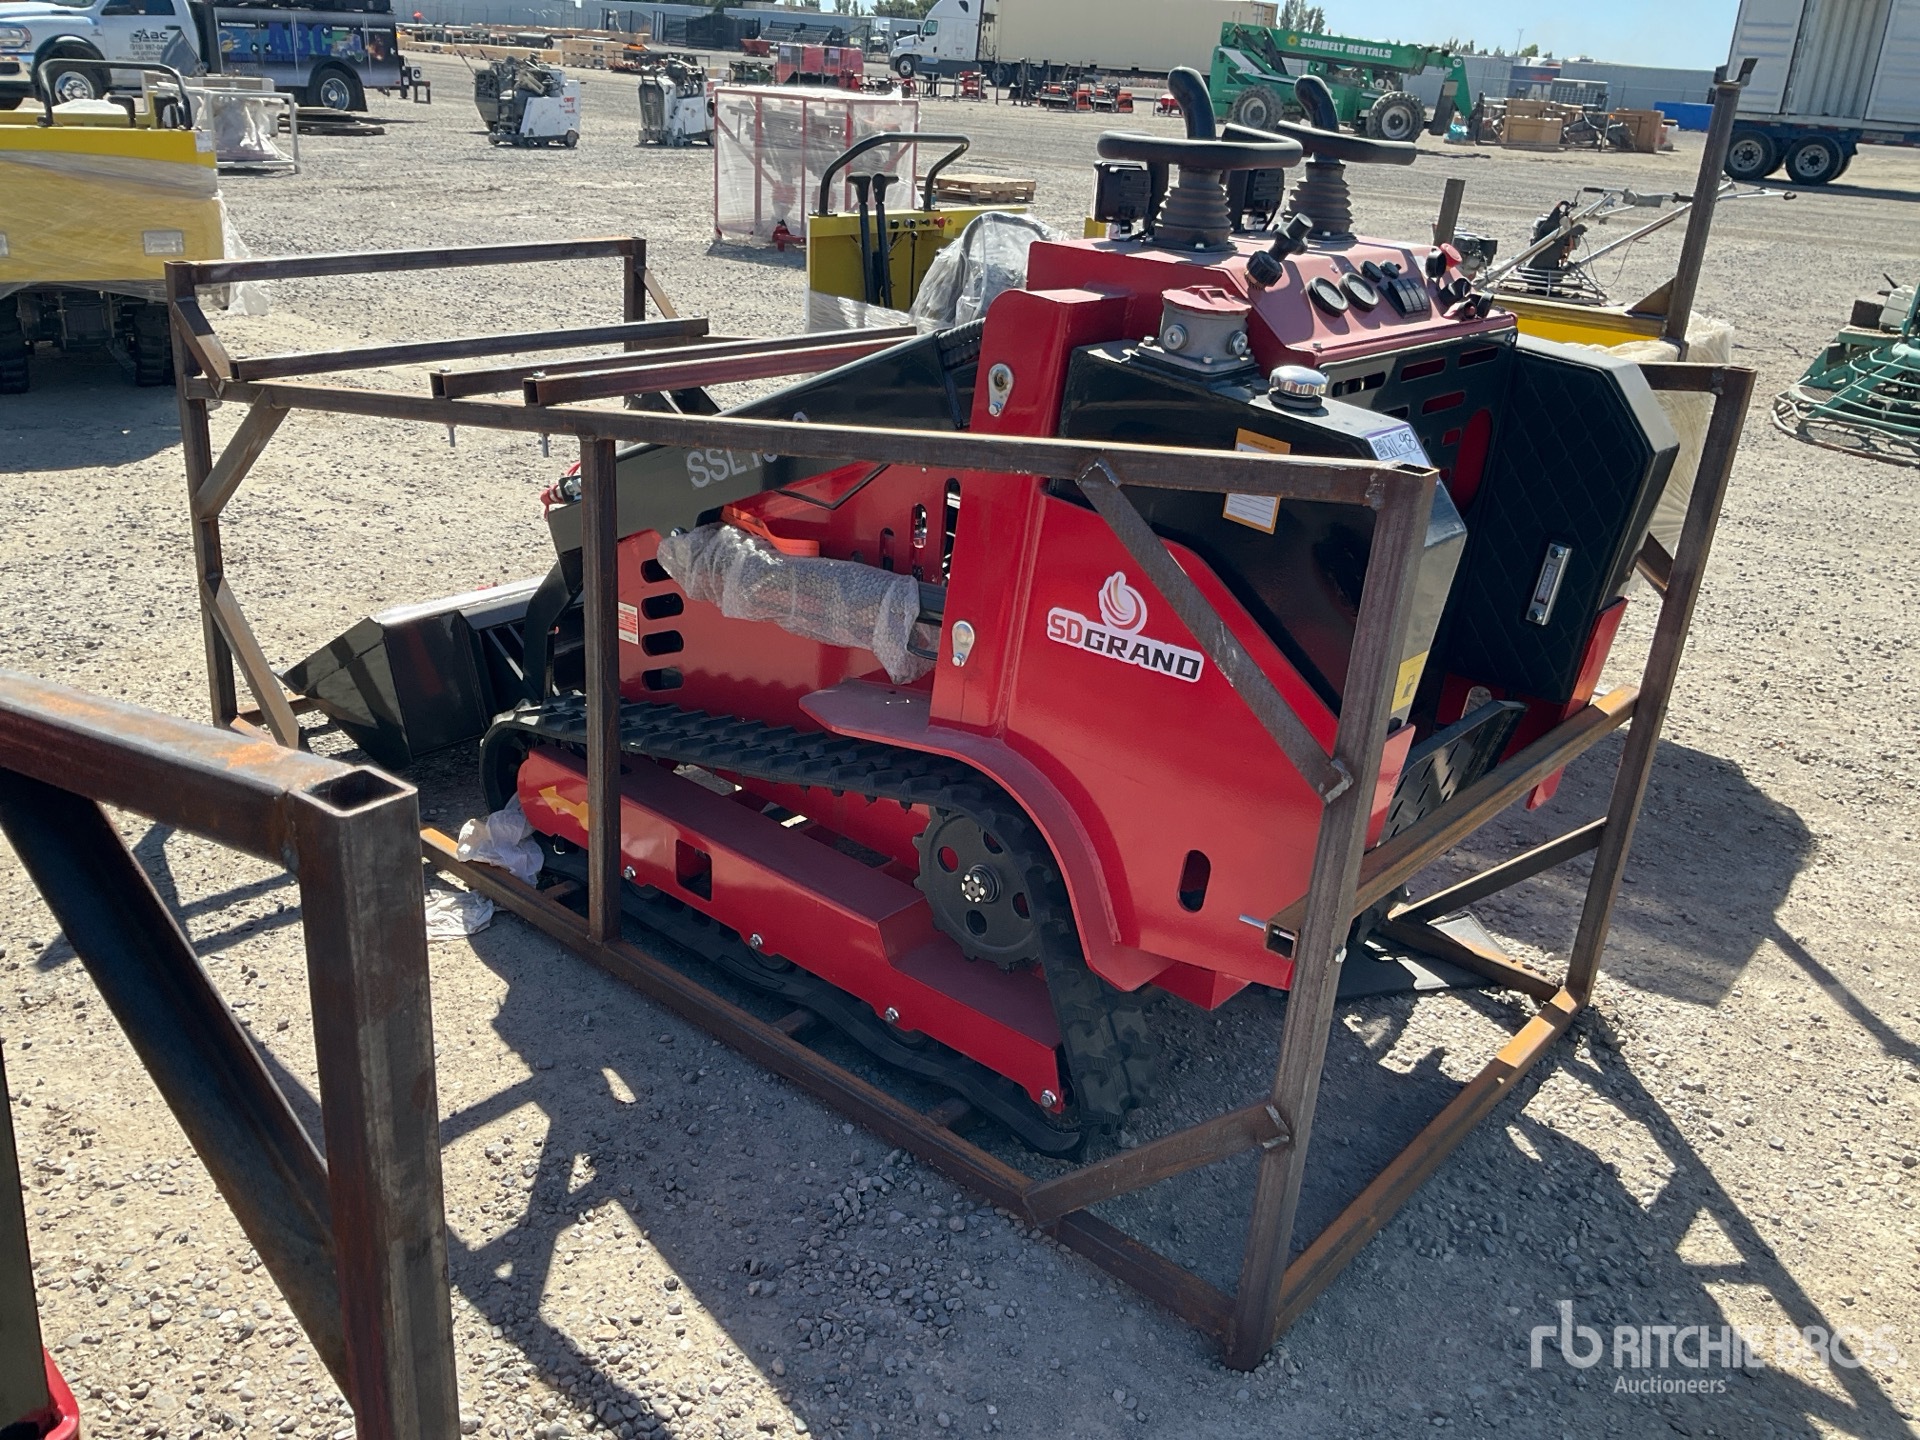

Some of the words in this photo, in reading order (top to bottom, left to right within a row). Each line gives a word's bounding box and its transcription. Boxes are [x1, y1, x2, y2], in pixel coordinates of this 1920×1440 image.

[140, 28, 168, 40] ABC
[268, 22, 332, 56] ABC
[1300, 38, 1346, 52] SUNBELT
[1346, 44, 1392, 59] RENTALS
[686, 449, 748, 488] SSL
[1049, 613, 1201, 680] SDGRAND
